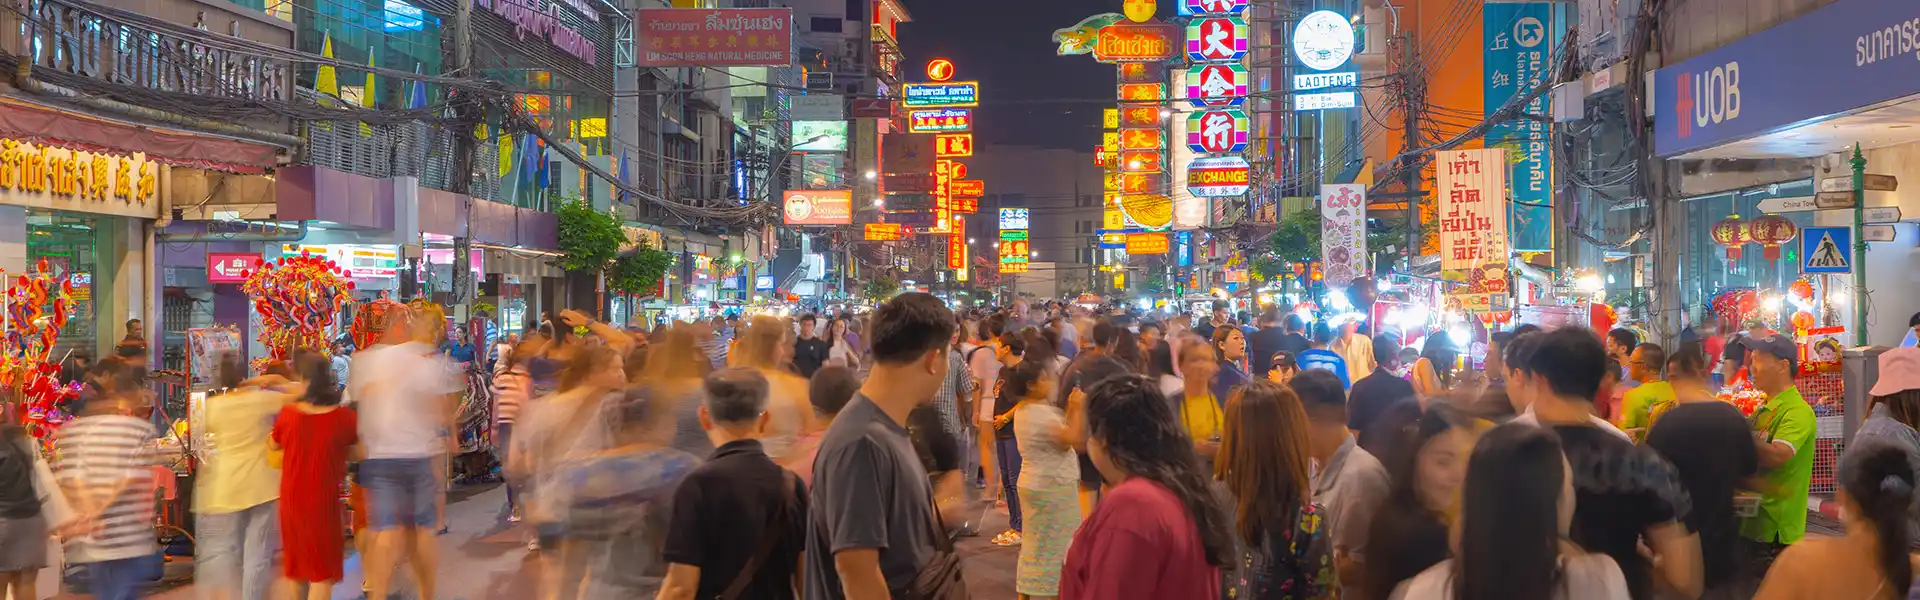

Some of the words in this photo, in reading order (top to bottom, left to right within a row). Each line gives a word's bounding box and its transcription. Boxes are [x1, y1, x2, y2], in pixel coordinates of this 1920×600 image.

[646, 52, 660, 61] LIM
[708, 51, 743, 61] NATURAL
[744, 51, 783, 60] MEDICINE
[1298, 75, 1353, 88] LAOTENG
[1696, 61, 1740, 127] UOB
[1189, 171, 1248, 184] EXCHANGE
[1783, 201, 1800, 209] China
[1802, 200, 1816, 208] Tow
